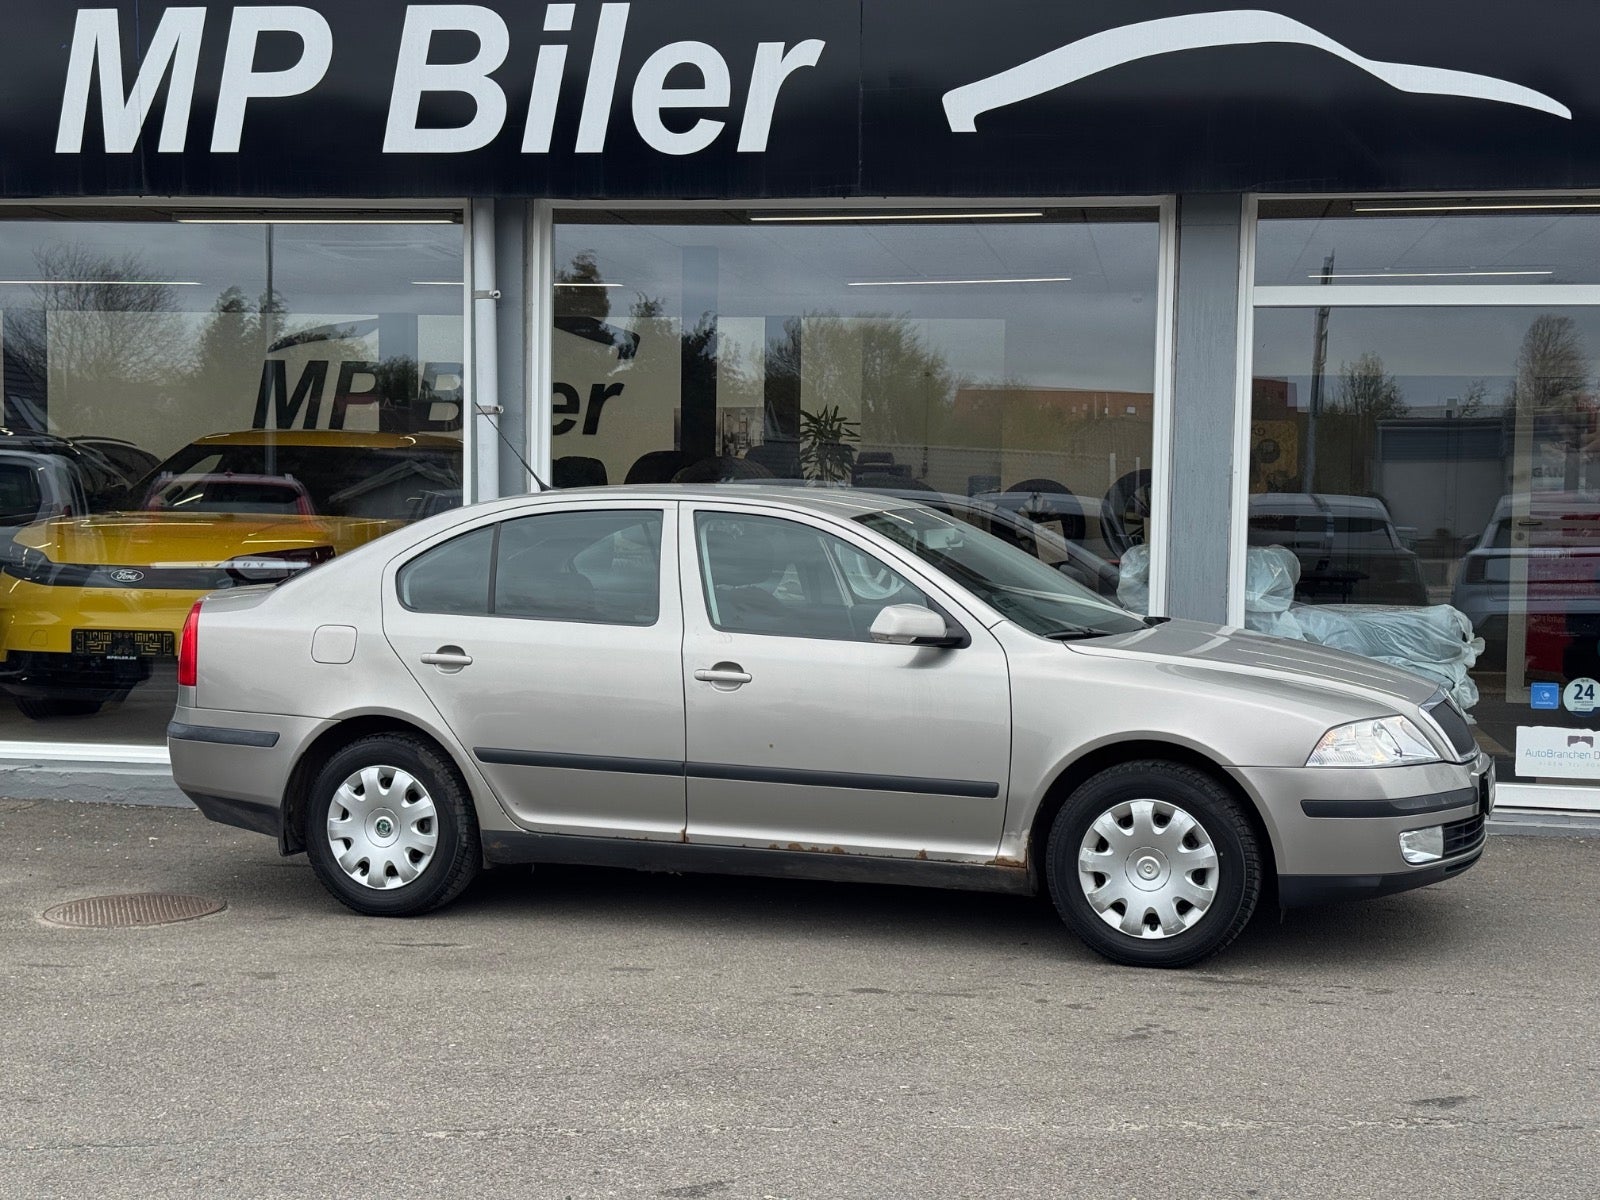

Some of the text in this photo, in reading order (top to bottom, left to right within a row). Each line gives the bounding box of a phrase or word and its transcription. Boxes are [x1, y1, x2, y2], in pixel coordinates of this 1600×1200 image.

[55, 2, 826, 156] MP Biler
[252, 359, 388, 431] MP
[1574, 684, 1595, 701] 24
[1525, 748, 1591, 759] AutoBranchen
